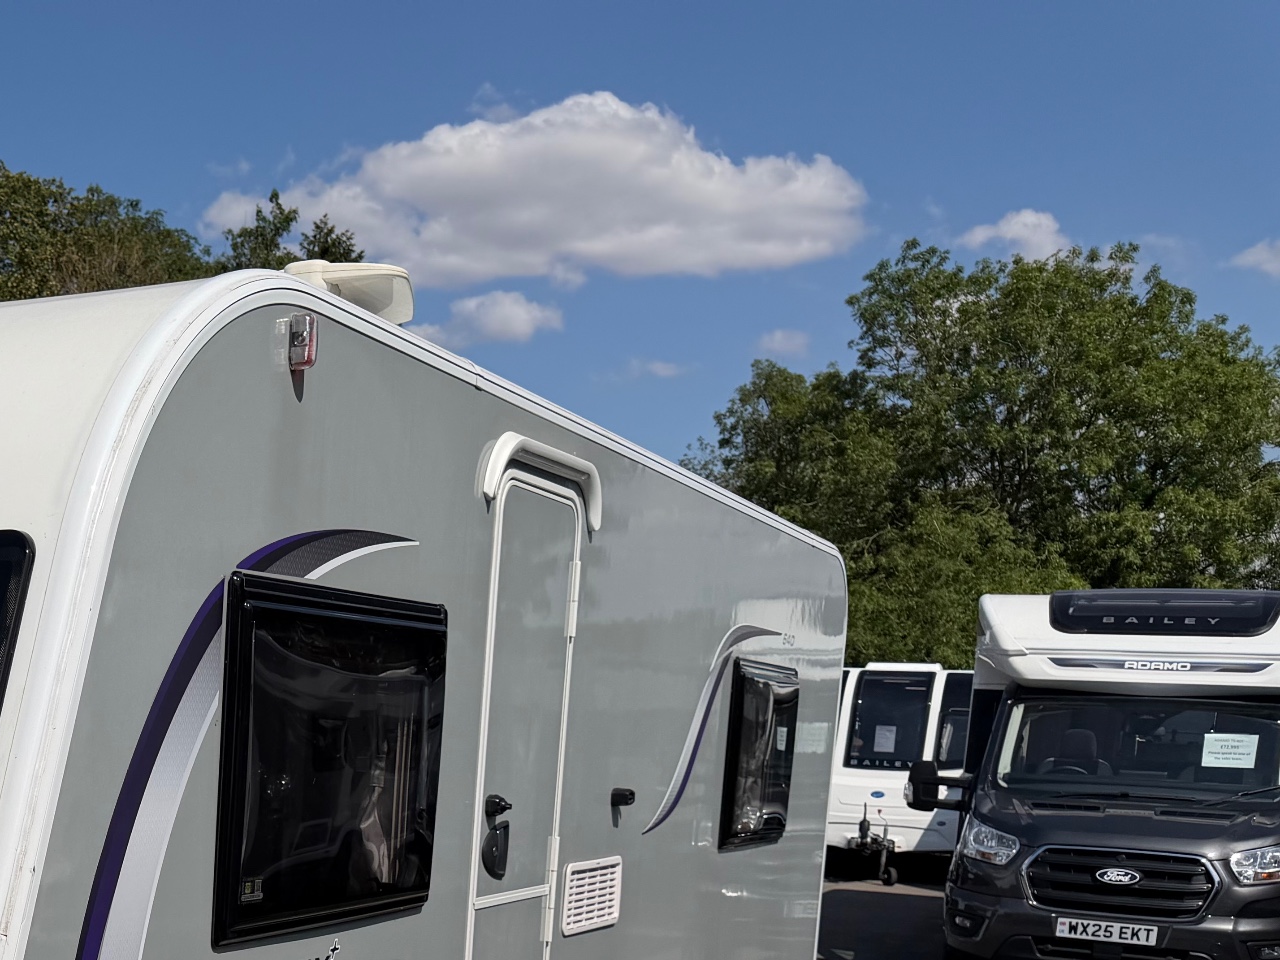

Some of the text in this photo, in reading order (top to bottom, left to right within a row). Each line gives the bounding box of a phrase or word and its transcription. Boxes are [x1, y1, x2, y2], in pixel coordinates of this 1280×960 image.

[1102, 616, 1220, 625] BAILEY
[1124, 661, 1191, 671] ADAMO
[850, 759, 914, 768] BAILEY
[1103, 870, 1132, 882] Ford
[1068, 921, 1154, 943] WX25 EKT
